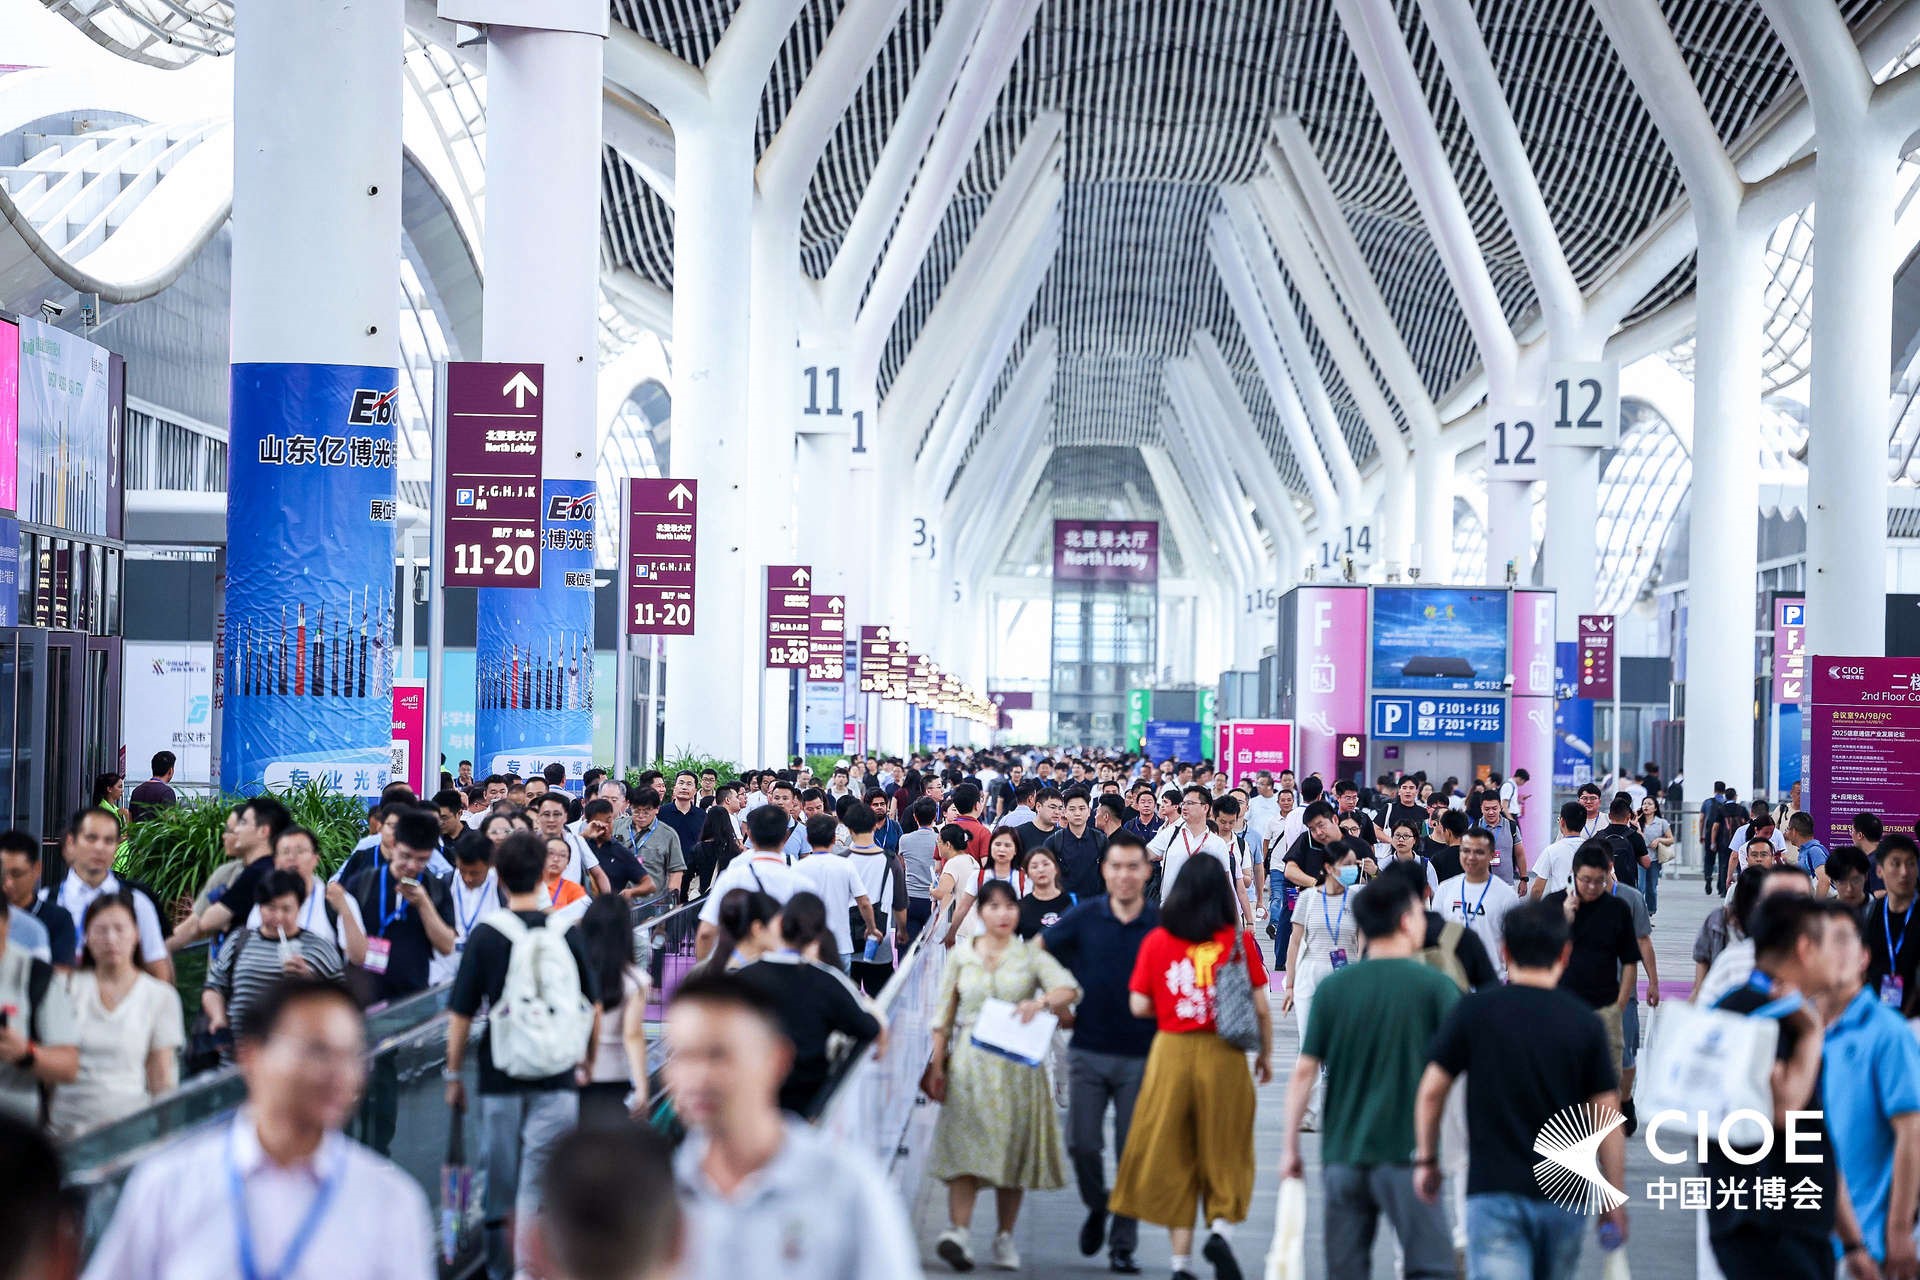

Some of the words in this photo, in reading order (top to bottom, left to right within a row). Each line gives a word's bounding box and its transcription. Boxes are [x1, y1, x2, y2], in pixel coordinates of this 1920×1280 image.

[803, 366, 843, 415] 11
[1555, 378, 1602, 428] 12
[111, 405, 118, 488] 9
[485, 443, 510, 452] North
[510, 443, 536, 455] Lobby
[1494, 421, 1536, 465] 12
[460, 491, 470, 503] P
[476, 499, 487, 510] M
[547, 495, 596, 520] Ebo
[541, 528, 594, 551] 博光电
[1064, 529, 1149, 549] 北登录大厅
[1344, 526, 1371, 554] 14
[454, 543, 535, 576] 11-20
[1063, 548, 1105, 567] North
[1106, 548, 1149, 571] Lobby
[1256, 588, 1276, 609] 16
[634, 603, 691, 625] 11-20
[1315, 601, 1332, 647] F
[1534, 599, 1548, 646] F
[1786, 606, 1800, 624] P
[1787, 630, 1799, 651] F
[770, 647, 809, 664] 11-20
[1841, 666, 1865, 675] CIOE
[1131, 691, 1142, 710] G
[1861, 691, 1879, 700] 2nd
[1882, 692, 1905, 701] Floor
[392, 721, 406, 729] uide
[1385, 704, 1402, 732] P
[1438, 703, 1466, 714] F101
[1473, 703, 1500, 715] F116
[1438, 719, 1465, 730] F201
[1473, 719, 1500, 731] F215
